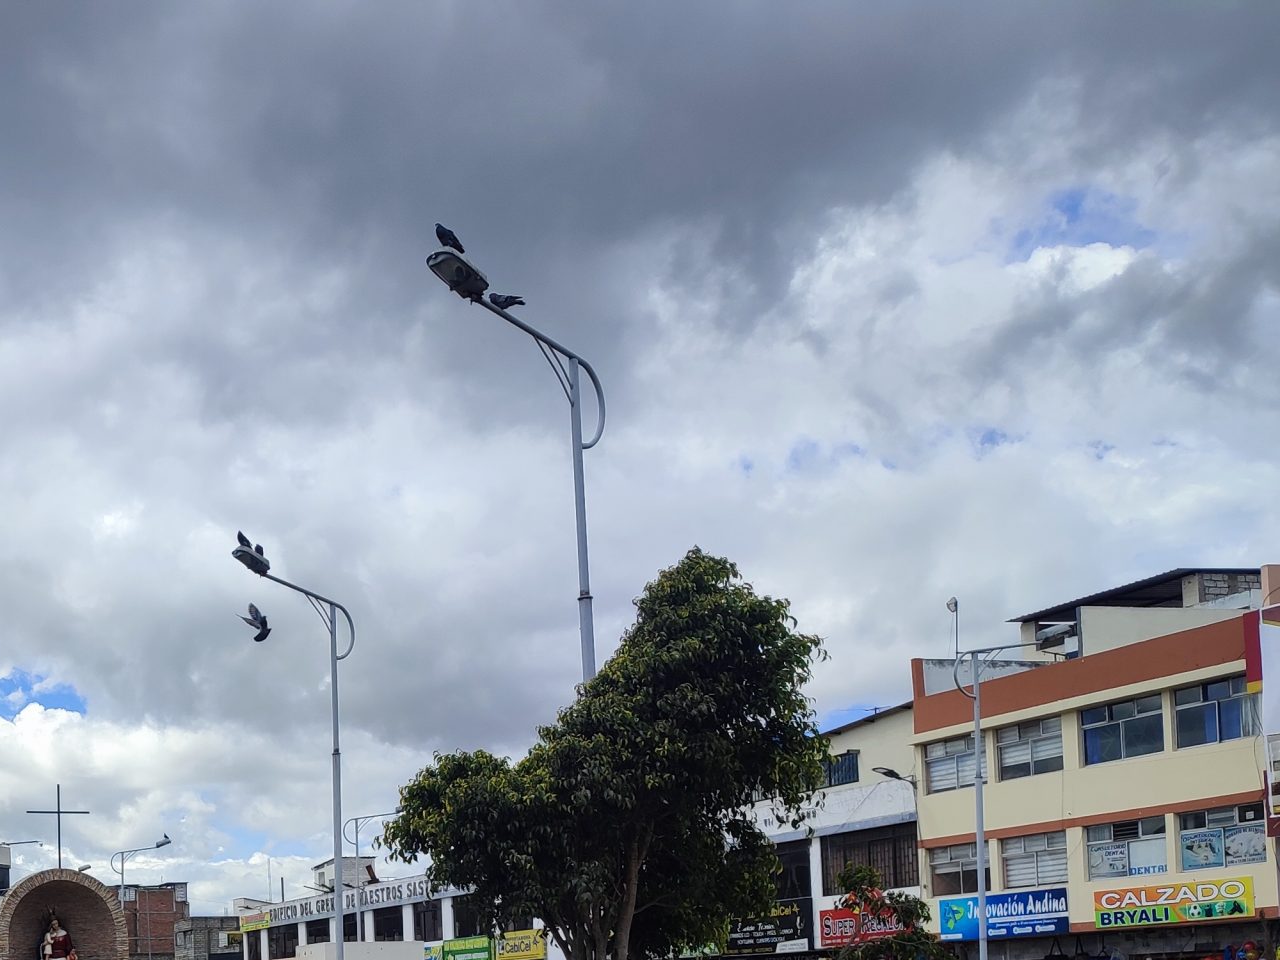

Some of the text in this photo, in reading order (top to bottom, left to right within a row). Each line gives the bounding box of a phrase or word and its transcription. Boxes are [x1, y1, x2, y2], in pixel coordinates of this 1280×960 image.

[270, 905, 297, 922] EDIFICIO
[300, 900, 314, 917] DEL
[346, 893, 356, 910] DE
[360, 884, 403, 907] MAESTROS
[967, 891, 1066, 919] Inovación Andina
[1101, 880, 1246, 910] CALZADO
[823, 916, 855, 937] SUPER
[1100, 907, 1169, 926] BRYALI
